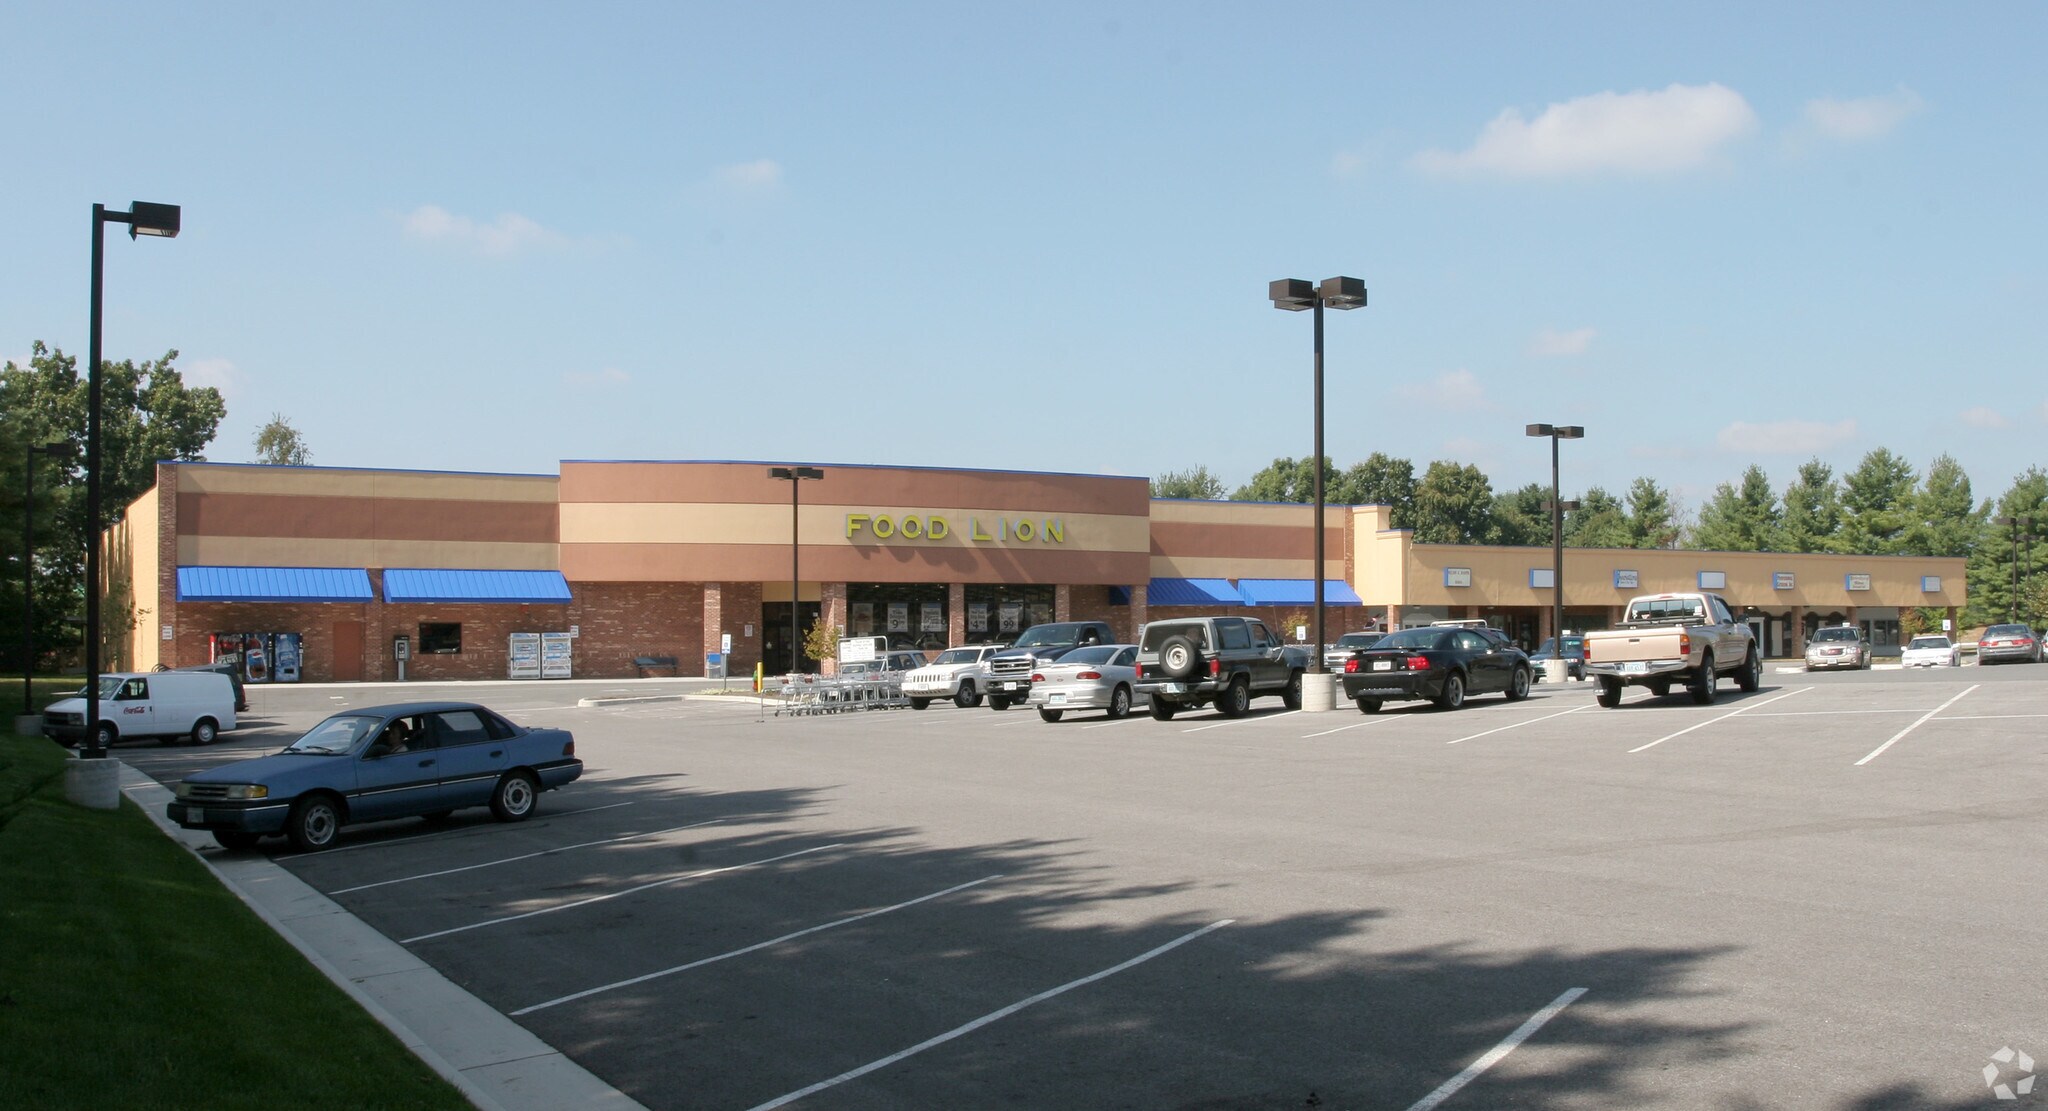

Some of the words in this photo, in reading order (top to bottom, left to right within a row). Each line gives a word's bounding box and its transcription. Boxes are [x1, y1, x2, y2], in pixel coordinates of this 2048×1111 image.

[846, 514, 949, 539] FOOD
[971, 517, 1064, 543] LION
[123, 706, 145, 715] Coca-Cola
